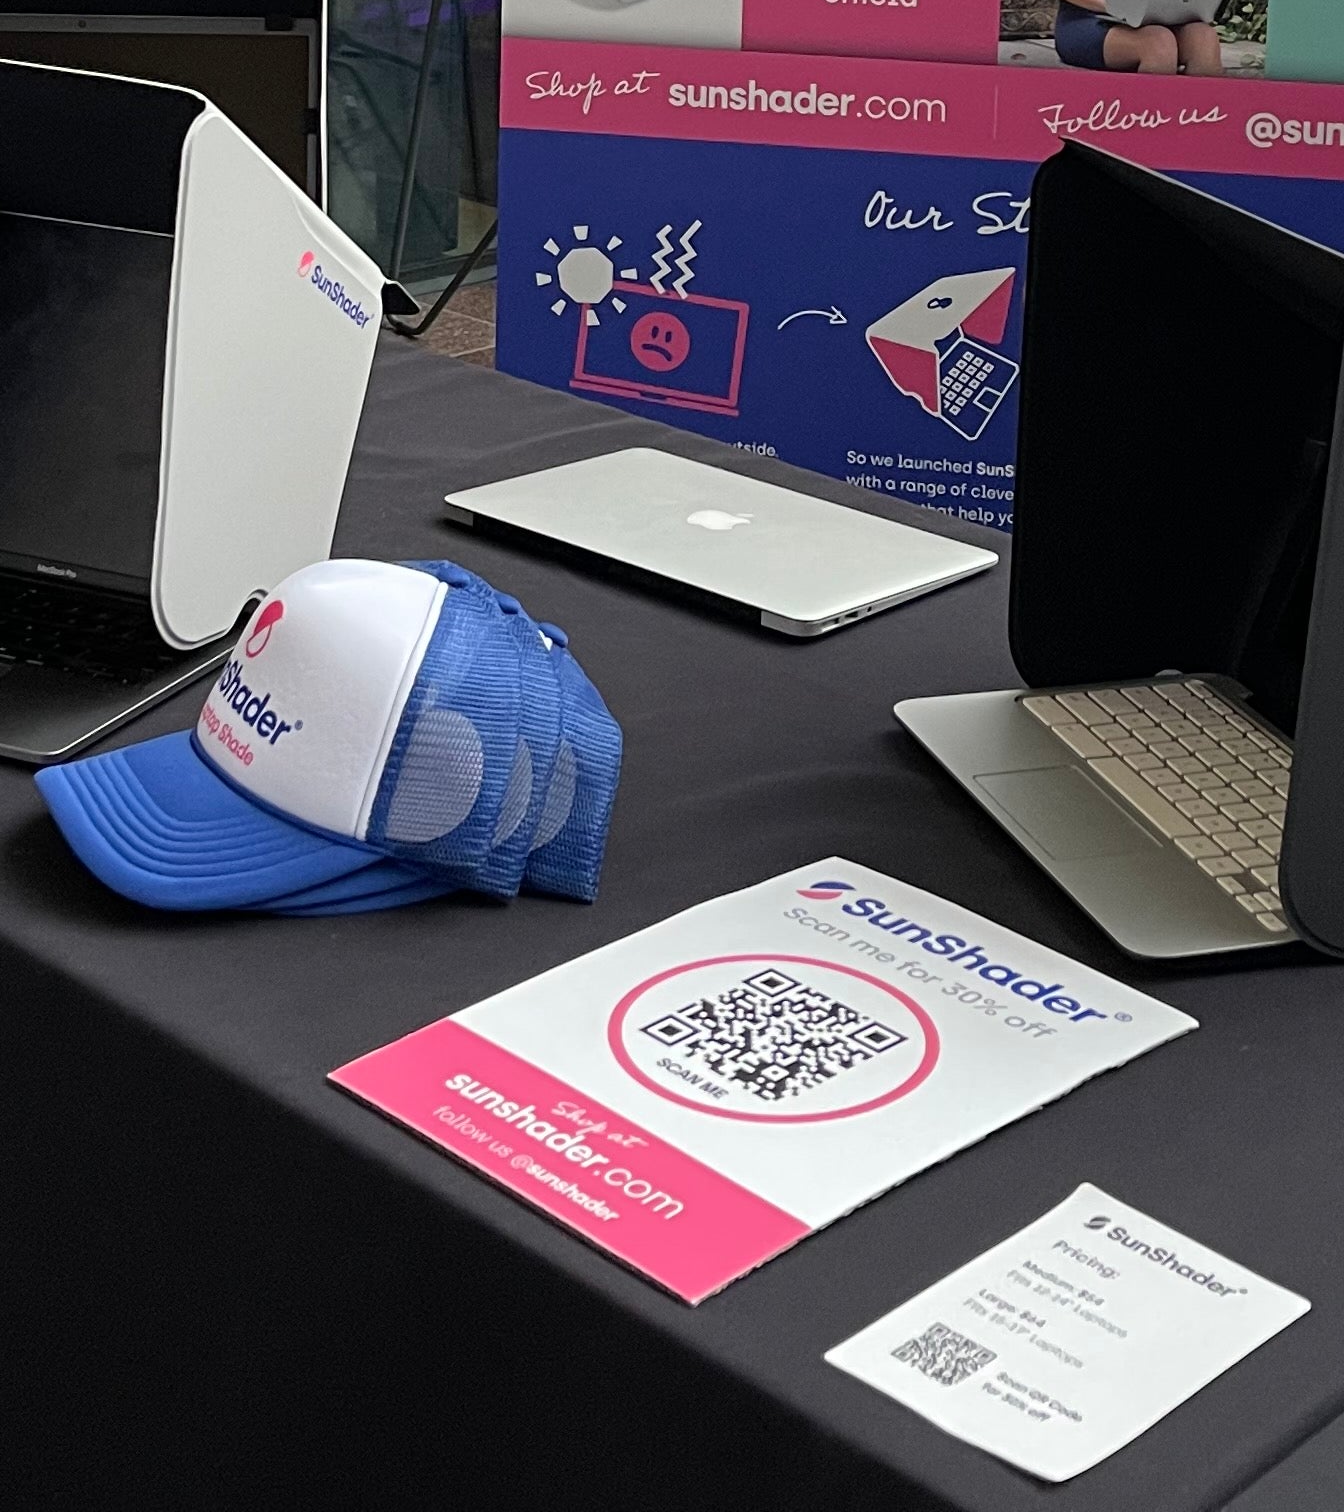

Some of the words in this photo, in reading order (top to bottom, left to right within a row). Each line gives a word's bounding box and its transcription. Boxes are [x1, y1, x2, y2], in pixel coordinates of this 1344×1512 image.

[525, 71, 607, 115] Shop
[614, 70, 661, 96] at
[668, 79, 946, 123] sunshader.com
[1038, 99, 1172, 134] Follow
[1178, 105, 1228, 125] us
[864, 190, 954, 233] Our
[311, 264, 371, 329] SunShader
[846, 473, 882, 489] with
[885, 478, 897, 490] a
[900, 480, 946, 497] range
[950, 483, 967, 496] of
[847, 450, 867, 465] So
[870, 454, 894, 468] we
[898, 454, 973, 475] launched
[958, 506, 994, 525] help
[783, 906, 850, 946] Scan
[855, 937, 897, 966] me
[896, 954, 943, 988] for
[942, 981, 1000, 1020] 30%
[1004, 1010, 1059, 1041] off
[655, 1055, 699, 1086] SCAN
[696, 1077, 728, 1100] ME
[444, 1072, 685, 1220] sunshader.com
[488, 1139, 515, 1160] us
[510, 1152, 621, 1223] @sunshader
[1107, 1225, 1241, 1298] SunShader
